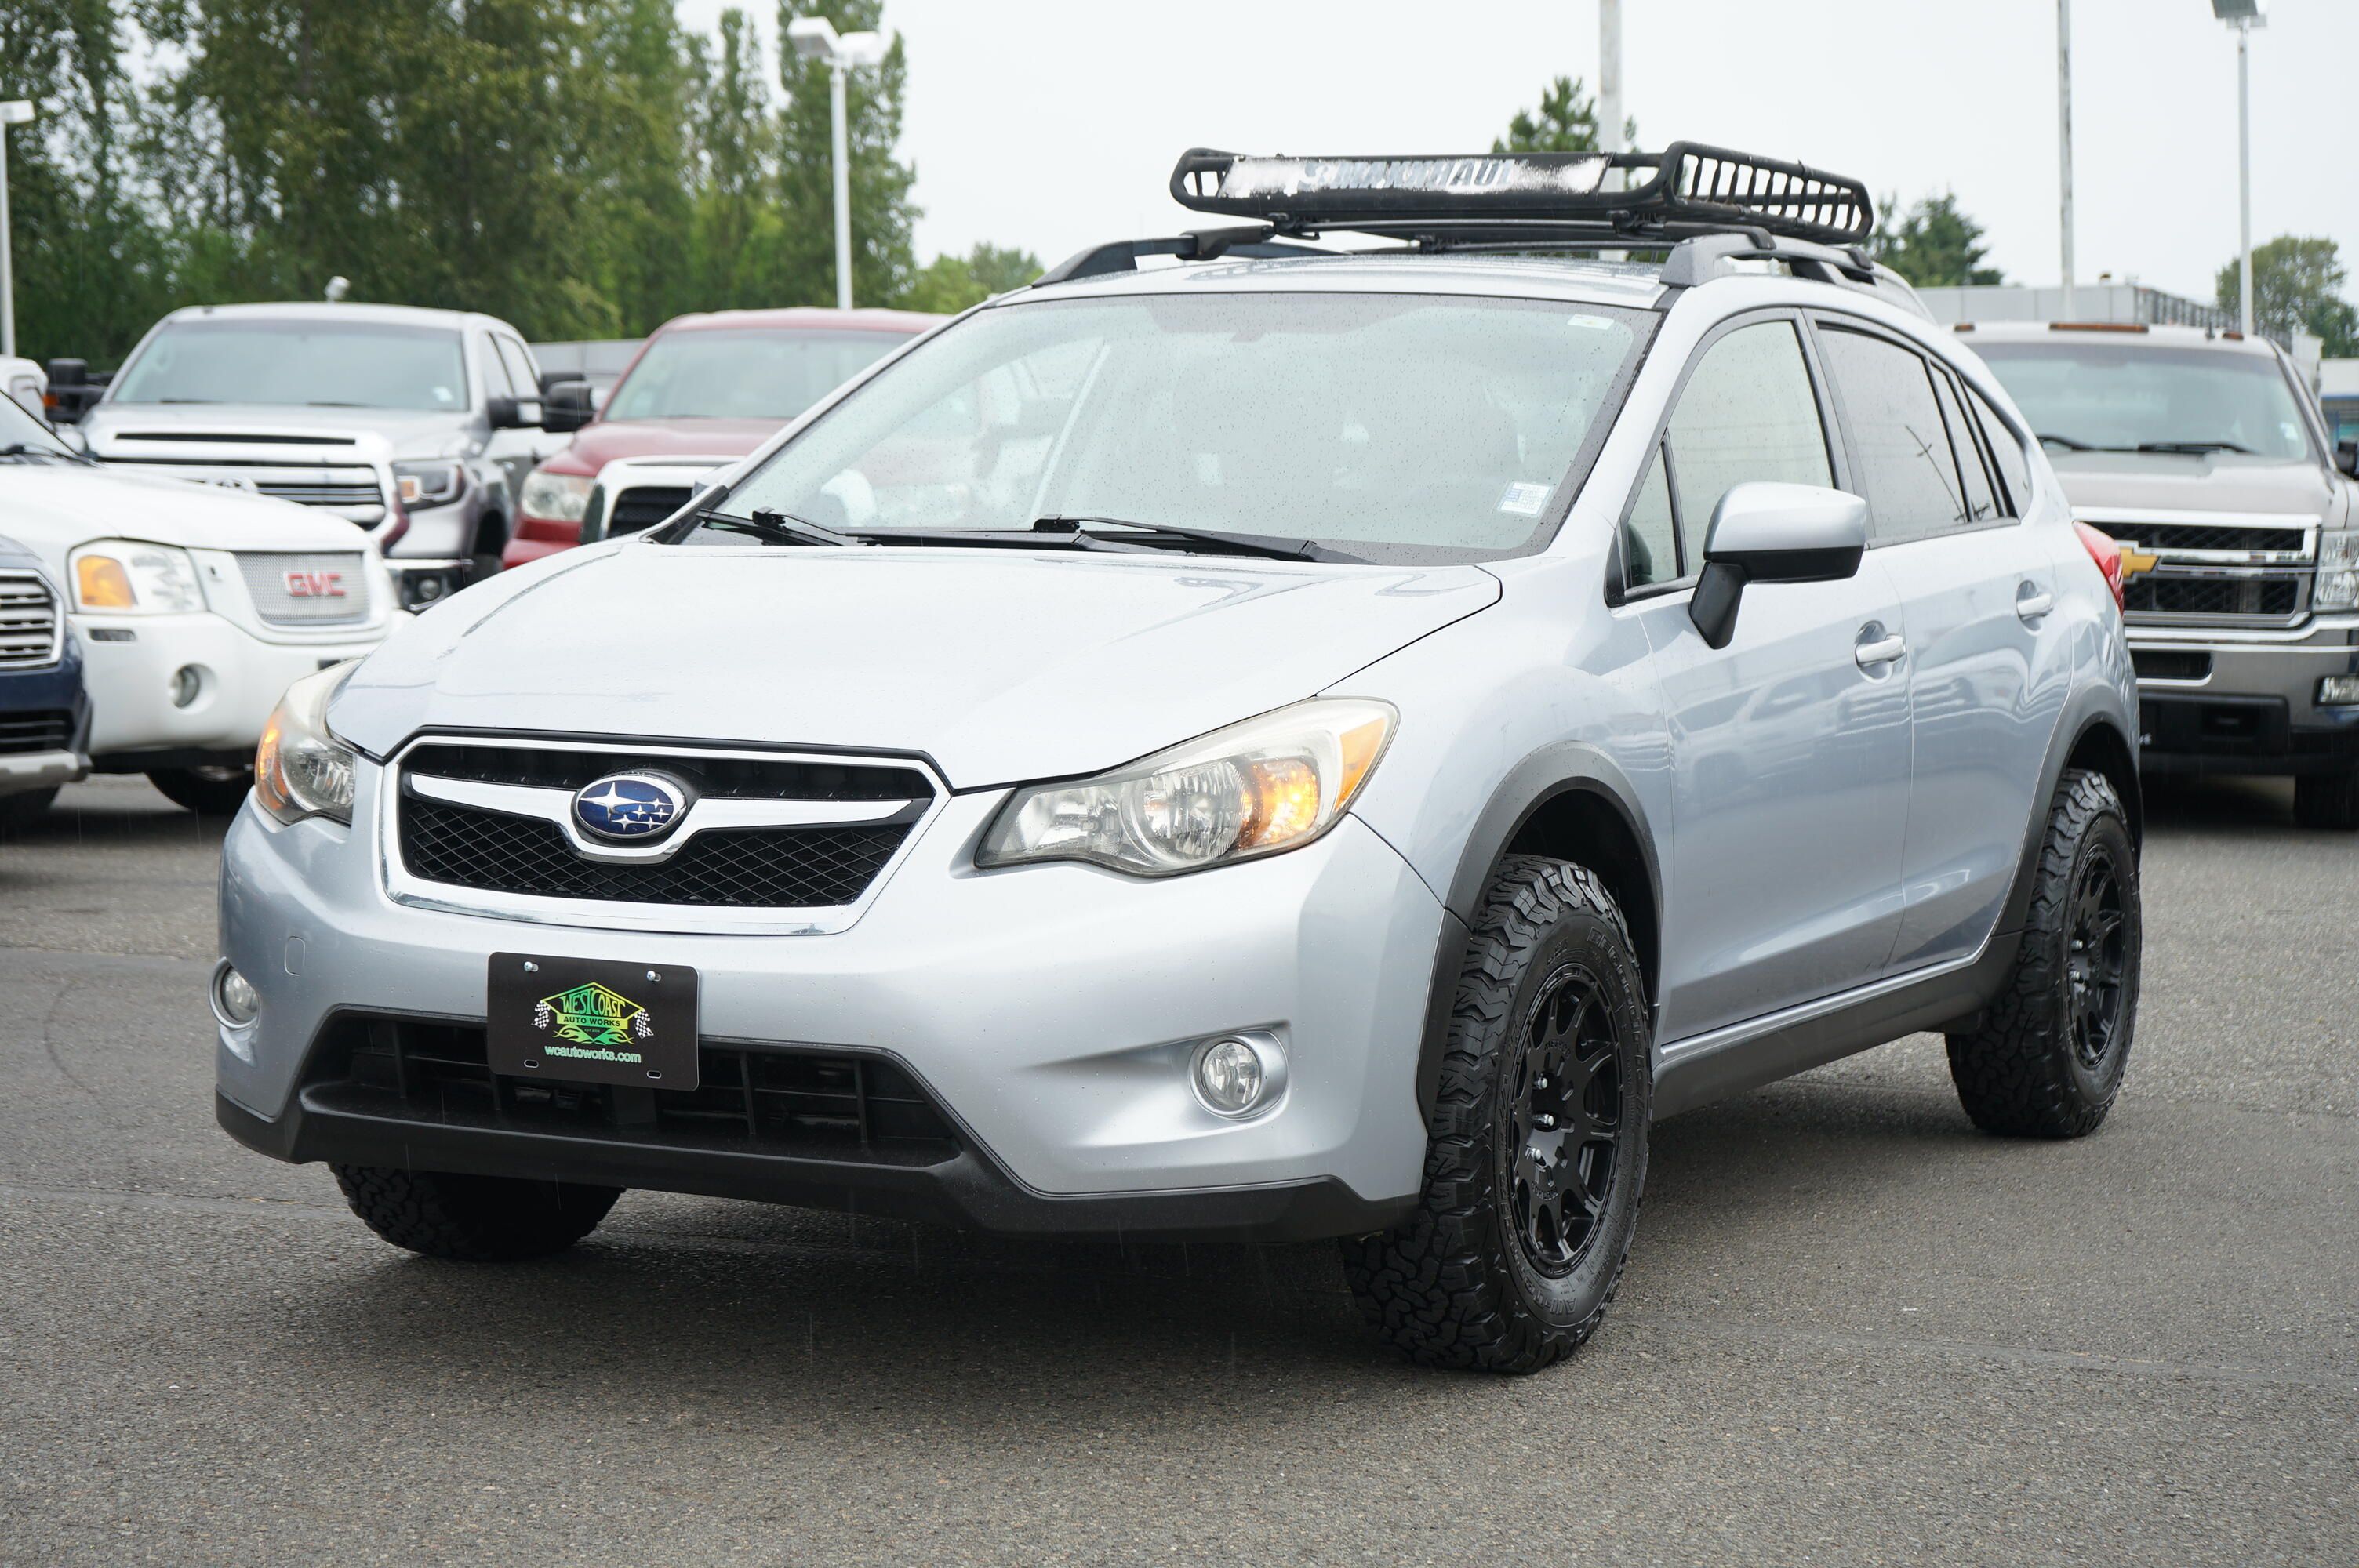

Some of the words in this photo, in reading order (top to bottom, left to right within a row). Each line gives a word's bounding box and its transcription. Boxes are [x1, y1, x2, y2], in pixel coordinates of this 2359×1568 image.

[283, 572, 347, 598] GMC
[589, 1018, 621, 1027] WORKS
[544, 1045, 642, 1063] wcautoworks.com
